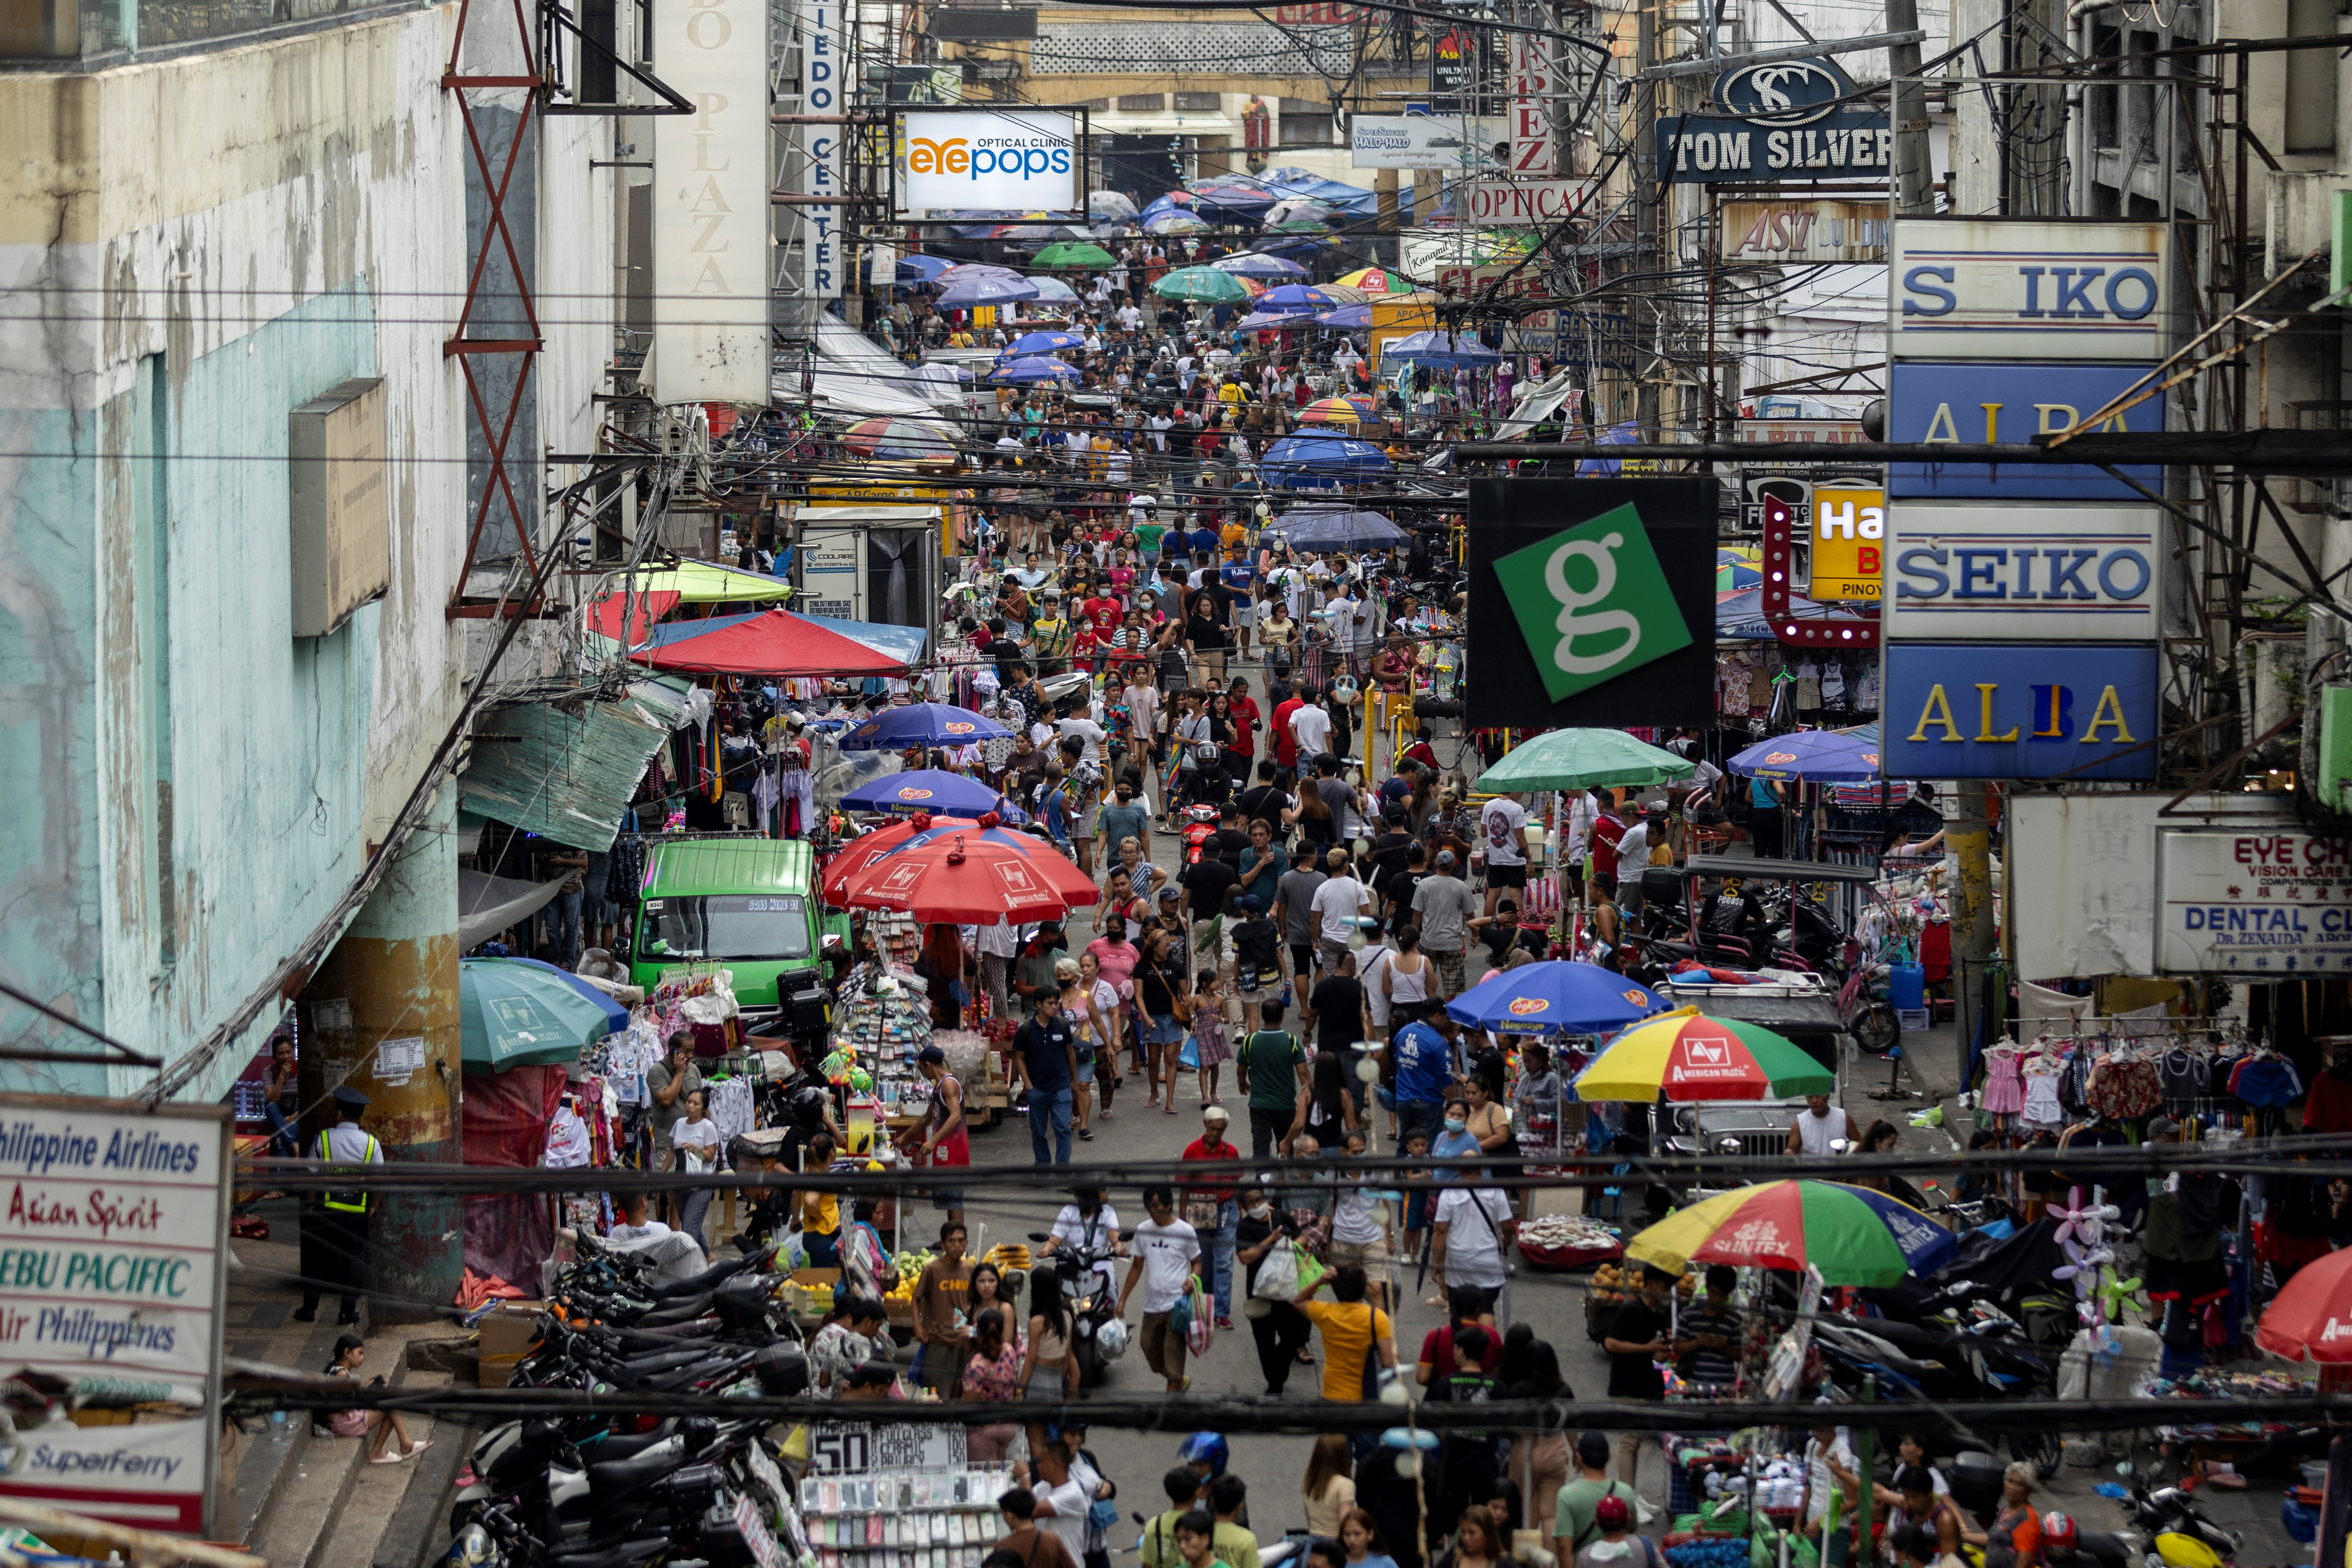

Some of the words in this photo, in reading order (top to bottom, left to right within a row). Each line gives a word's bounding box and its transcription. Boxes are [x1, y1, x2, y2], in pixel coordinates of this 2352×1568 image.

[1515, 34, 1551, 170] EREZ
[978, 138, 1028, 148] OPTICAL
[1031, 138, 1070, 148] CLINIC
[1354, 136, 1411, 149] HALO-HALO
[1669, 132, 1751, 171] TOM
[689, 92, 733, 293] PLAZA
[1471, 187, 1593, 218] OPTICAL
[813, 138, 832, 290] CENTER
[1727, 209, 1819, 257] AST
[1896, 547, 2150, 600] SEIKO
[1907, 683, 2137, 743] ALBA
[1755, 768, 1786, 778] Negosyo
[2234, 837, 2294, 864] EYE
[2247, 865, 2298, 877] VISION
[2303, 865, 2343, 878] CARE
[2259, 878, 2334, 887] COMPUTERIZED
[748, 899, 767, 911] BOSS
[768, 898, 788, 911] MIKE
[1003, 892, 1034, 909] AMERICAN
[2184, 907, 2308, 932] DENTAL
[2238, 932, 2303, 945] ZENAIDA
[1501, 1019, 1545, 1030] Negosyo
[1672, 1065, 1720, 1082] AMERICAN
[102, 1126, 201, 1175] Airlines
[549, 1139, 572, 1150] Jollibee
[9, 1179, 80, 1228] Asian
[86, 1188, 164, 1238] Spirit
[1713, 1238, 1790, 1257] SUNTEX
[1897, 1223, 1940, 1255] SUNTEX
[815, 1431, 870, 1476] 50
[880, 1440, 925, 1455] CERAMIC
